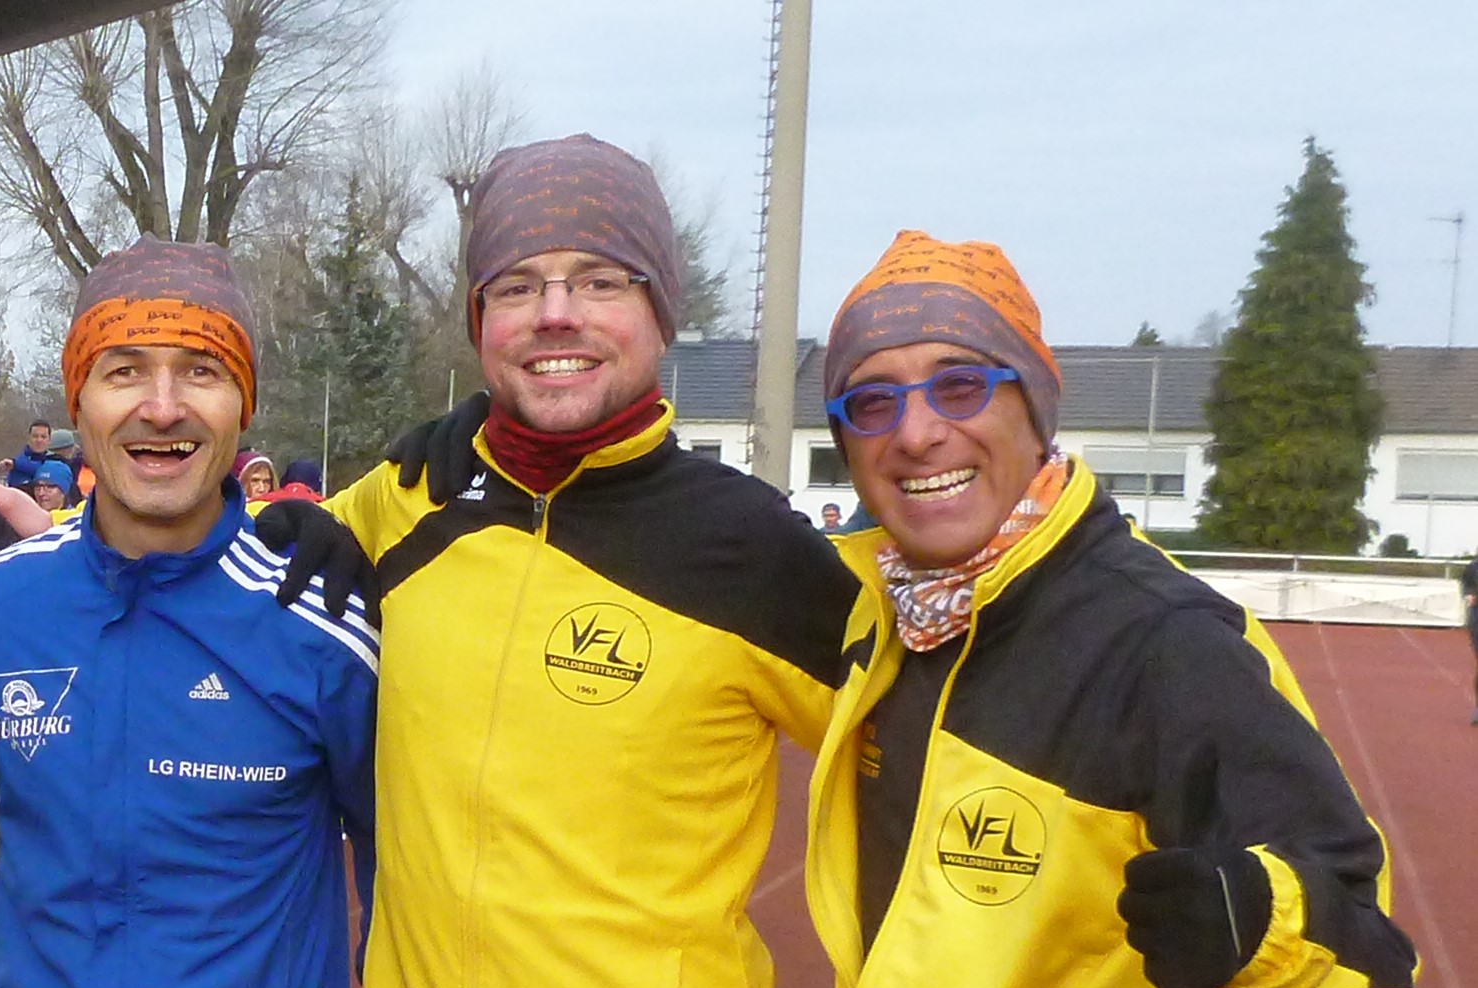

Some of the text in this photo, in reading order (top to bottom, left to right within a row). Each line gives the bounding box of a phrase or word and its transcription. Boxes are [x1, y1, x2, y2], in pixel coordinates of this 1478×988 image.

[548, 656, 635, 680] WALDBREITBACH
[189, 689, 230, 701] adidas
[576, 685, 598, 696] 1969
[148, 758, 287, 782] LG RHEIN-WIED
[943, 854, 1036, 873] WALDBREITBACH
